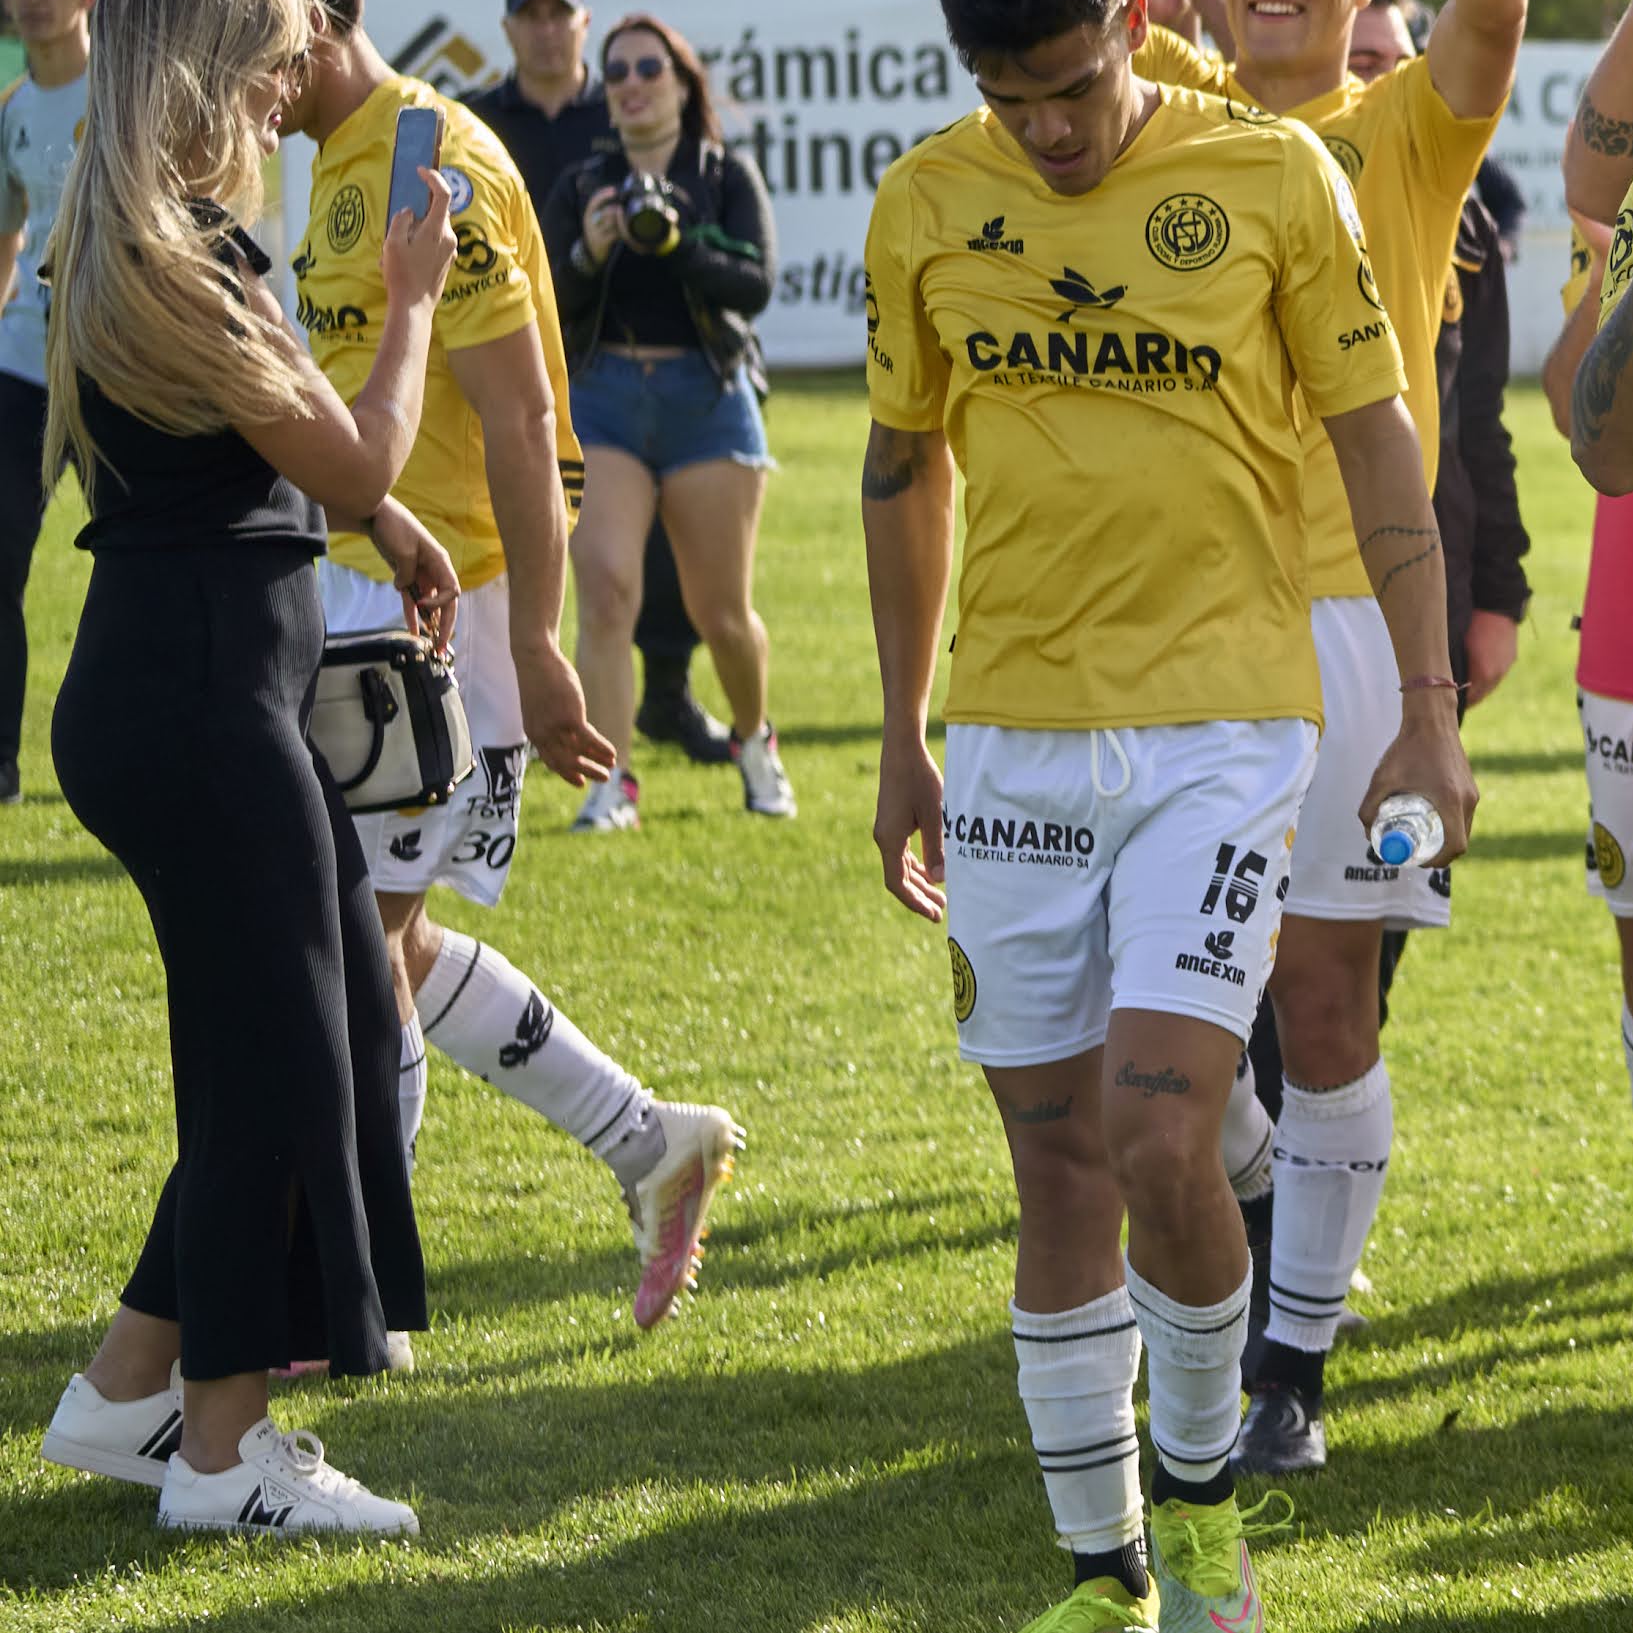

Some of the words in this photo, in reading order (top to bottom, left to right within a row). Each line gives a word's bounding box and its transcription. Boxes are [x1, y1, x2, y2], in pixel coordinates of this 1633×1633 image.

[966, 331, 1222, 383] CANARIO
[452, 830, 516, 869] 30
[956, 814, 1095, 855] CANARIO
[958, 848, 968, 859] AL
[970, 847, 1015, 863] TEXTILE
[1018, 851, 1074, 868] CANARIO
[1076, 856, 1090, 869] SA
[1200, 842, 1268, 924] 16
[1175, 952, 1246, 988] ANGEXIA
